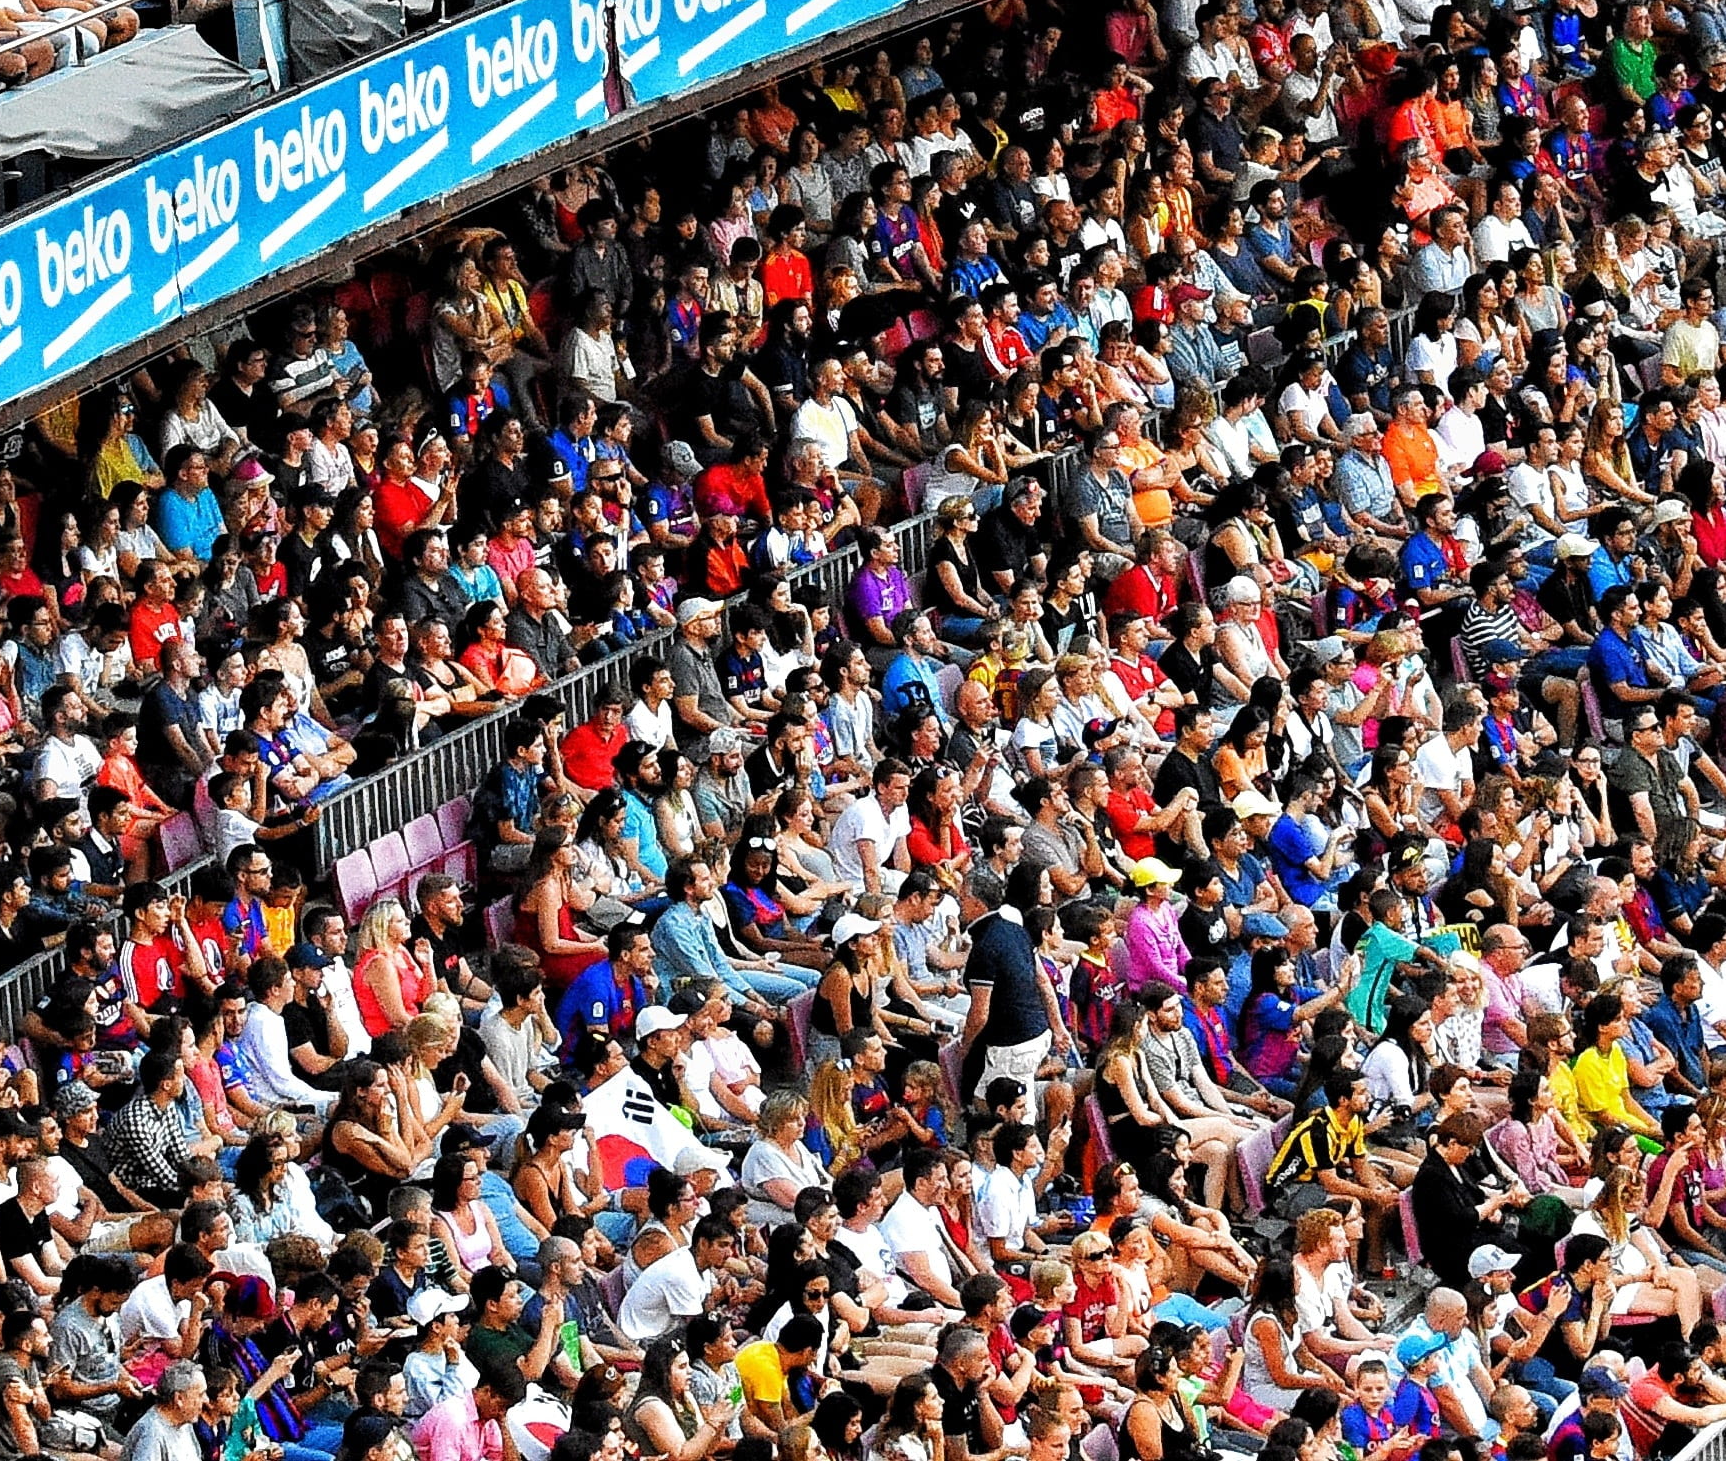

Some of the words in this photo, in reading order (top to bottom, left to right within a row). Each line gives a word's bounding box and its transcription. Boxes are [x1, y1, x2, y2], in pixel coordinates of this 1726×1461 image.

[36, 205, 132, 308] beko
[145, 154, 240, 255] beko
[254, 105, 347, 204] beko
[359, 59, 450, 155] beko
[466, 14, 558, 109] beko
